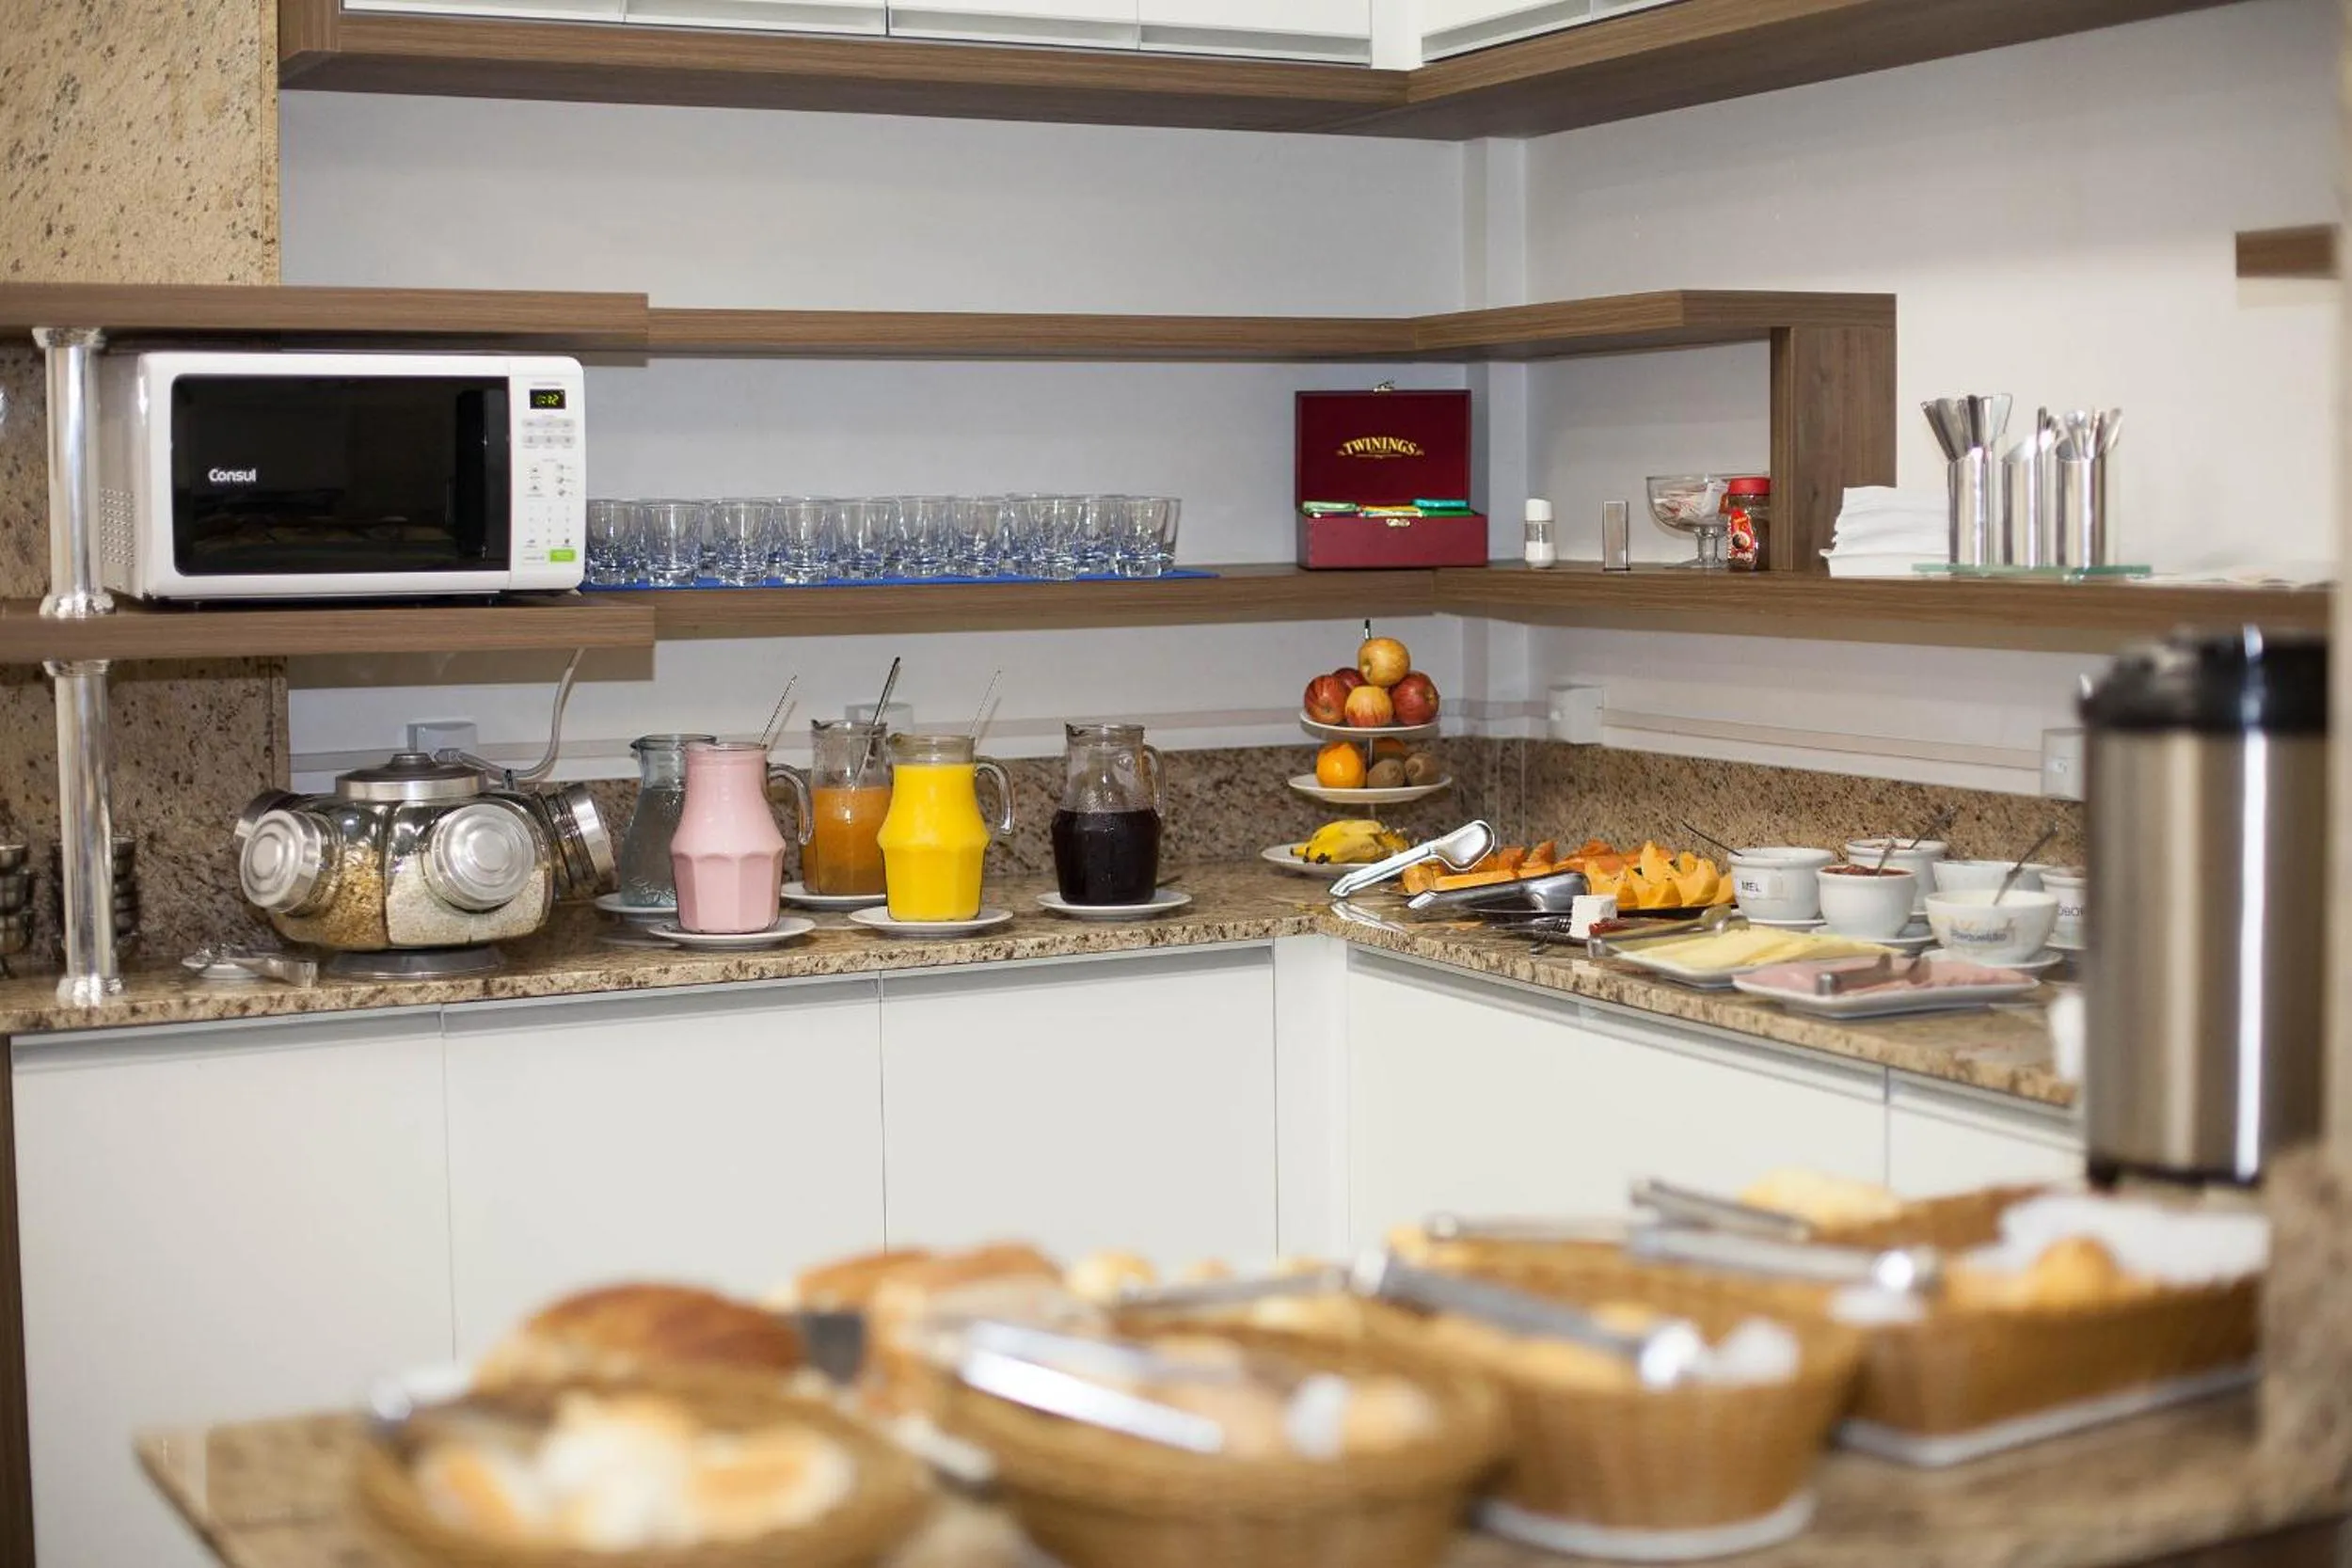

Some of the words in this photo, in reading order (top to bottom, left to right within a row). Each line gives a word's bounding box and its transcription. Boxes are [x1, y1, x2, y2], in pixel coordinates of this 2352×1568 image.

[1343, 436, 1417, 455] TWININGS
[208, 468, 257, 483] Consul
[1741, 879, 1762, 893] MEL
